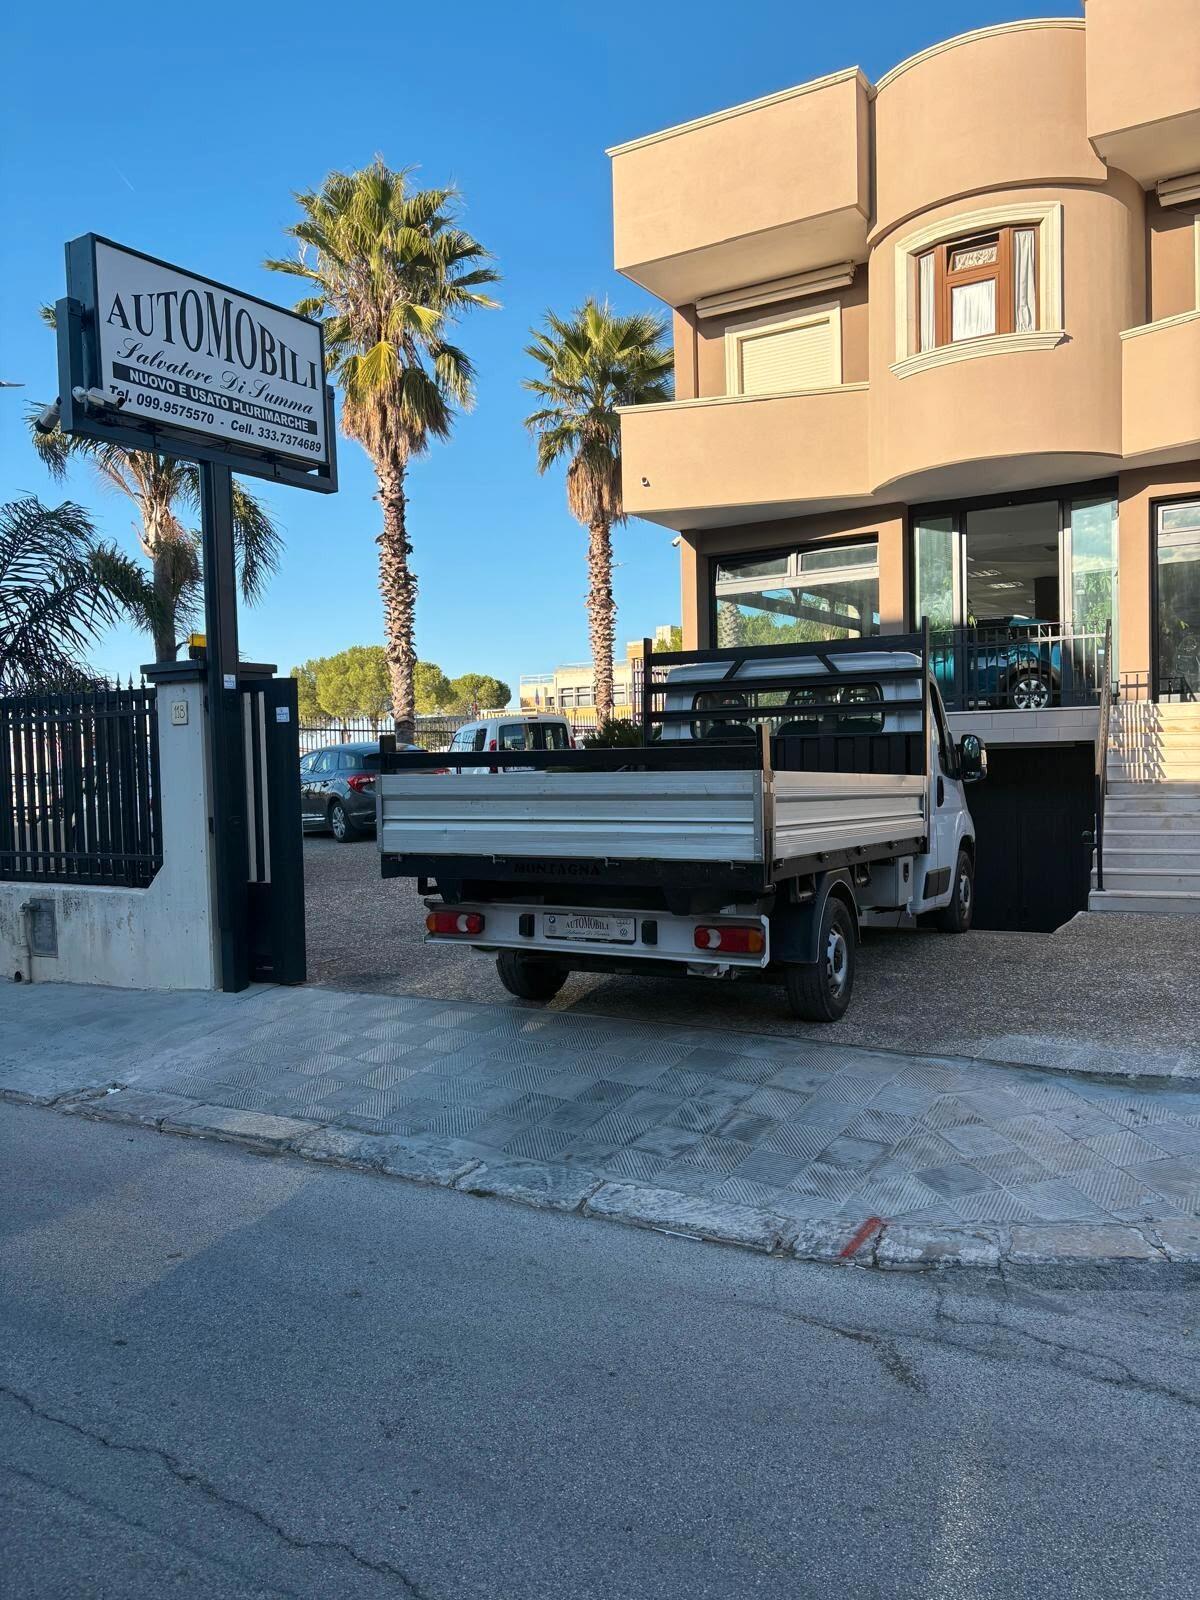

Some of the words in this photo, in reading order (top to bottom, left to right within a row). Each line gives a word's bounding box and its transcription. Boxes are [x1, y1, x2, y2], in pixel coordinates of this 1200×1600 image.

[107, 289, 318, 391] AUTOMOBILI
[117, 337, 213, 384] Salvatore
[219, 370, 245, 394] Di
[248, 379, 313, 415] Summa
[129, 369, 175, 393] NUOVO
[179, 384, 187, 397] E
[190, 388, 229, 409] USATO
[232, 402, 309, 431] PLURIMARCHE
[136, 392, 214, 425] 099.9575570
[230, 419, 254, 436] Cell.
[257, 427, 322, 453] 333.7374689
